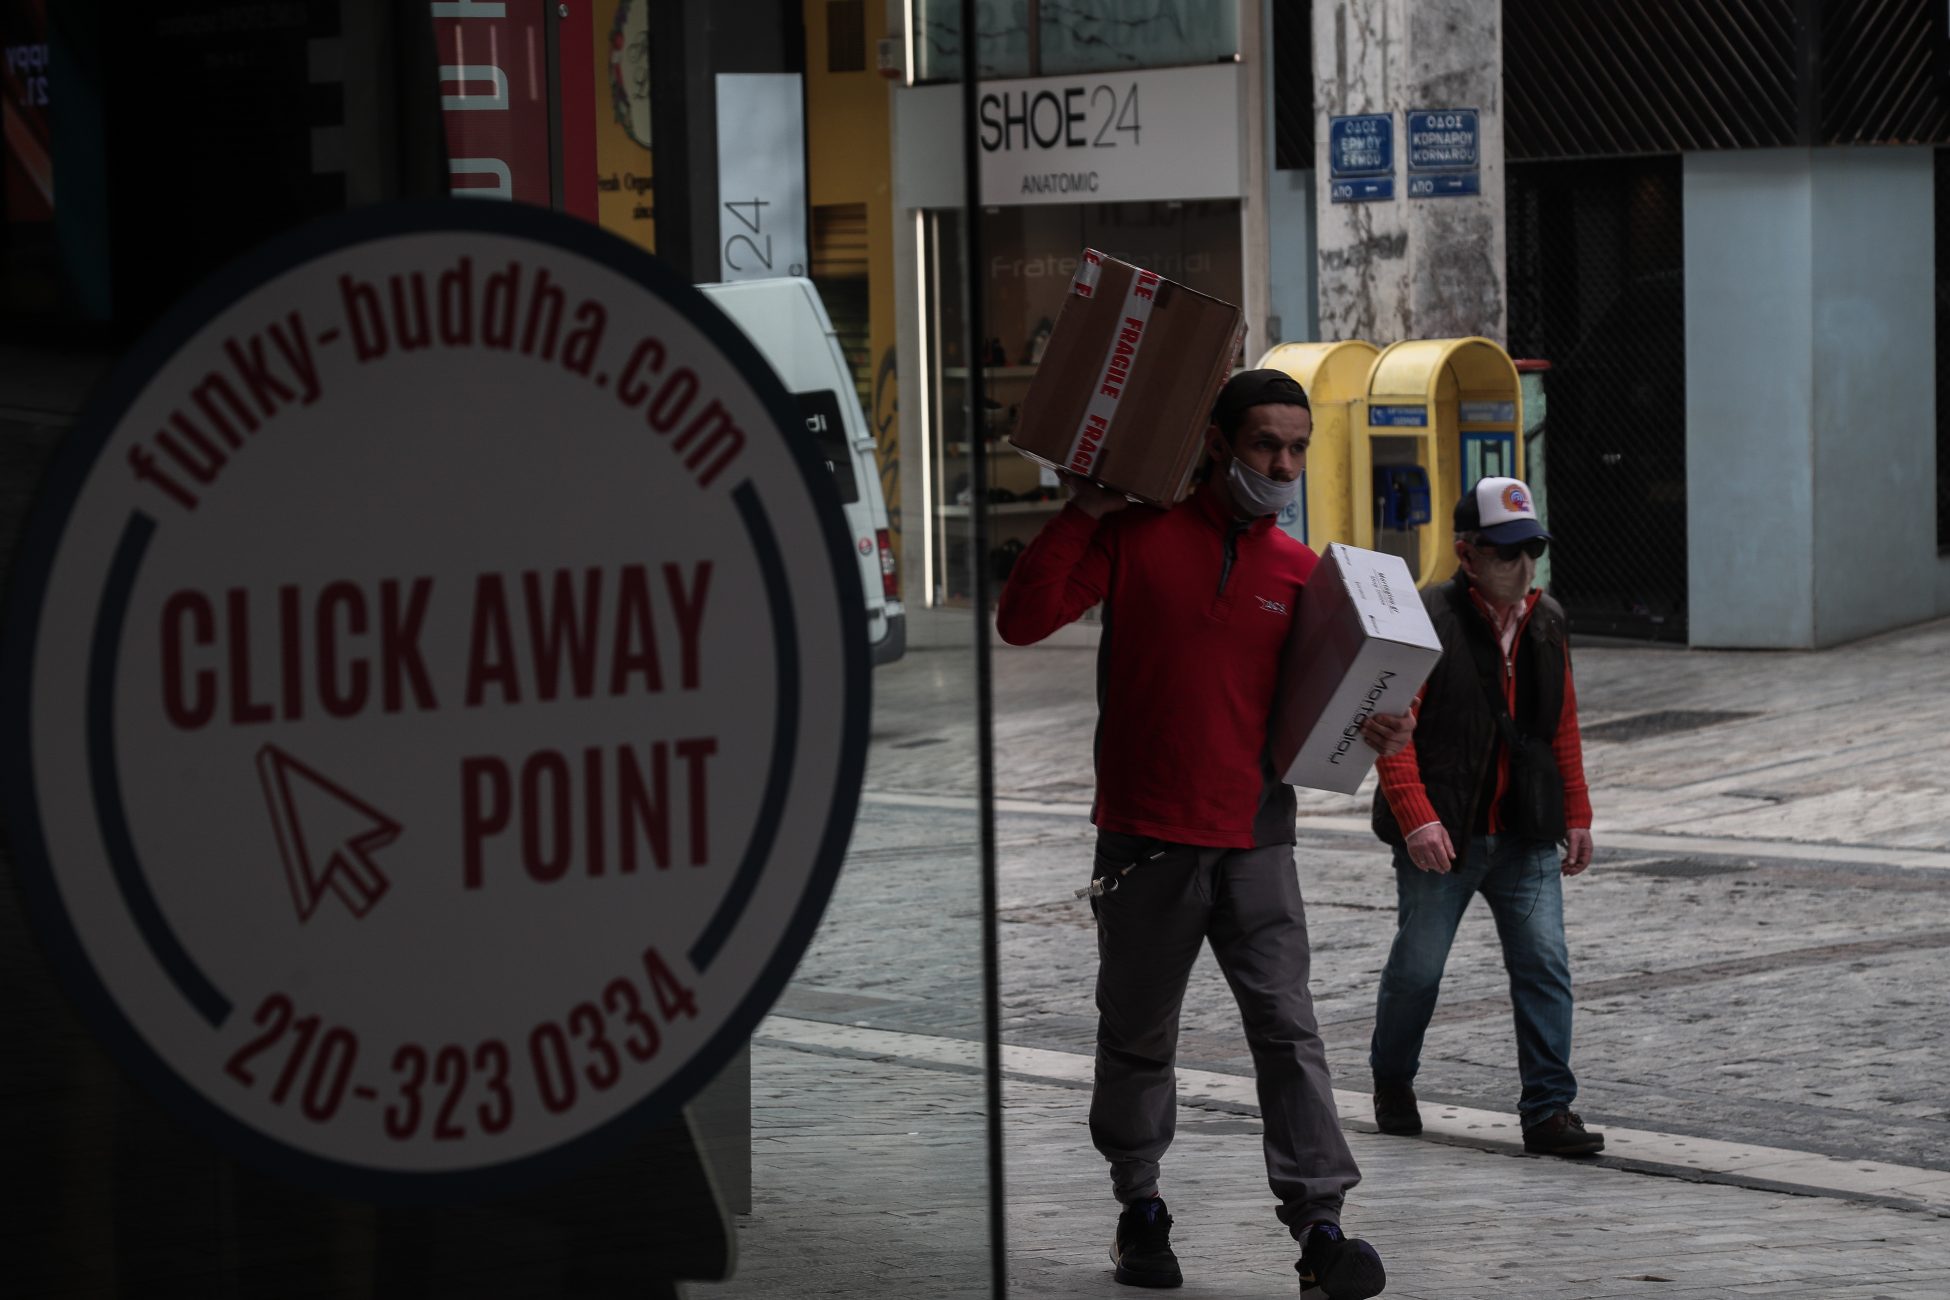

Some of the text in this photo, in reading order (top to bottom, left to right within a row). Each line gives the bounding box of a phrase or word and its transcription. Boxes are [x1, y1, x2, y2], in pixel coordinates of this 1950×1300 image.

[1344, 120, 1378, 134] ΟΔΟΣ
[1425, 115, 1464, 129] ΟΔΟΣ
[1340, 136, 1383, 151] ΕΡΜΟΥ
[1412, 131, 1474, 146] ΚΟΡΝΑΡΟΥ
[1341, 151, 1382, 167] ERMOU
[1412, 148, 1475, 161] KORNAROU
[1021, 171, 1100, 195] ANATOMIC
[1411, 180, 1434, 194] ΑΠΟ
[1333, 185, 1353, 199] ΑΠΟ
[990, 255, 1078, 280] Frate
[1100, 316, 1144, 400] FRAGILE
[126, 256, 748, 511] funky-buddha.com
[159, 560, 713, 731] CLICK AWAY
[461, 738, 718, 890] POINT
[225, 947, 698, 1141] 210-323 0334
